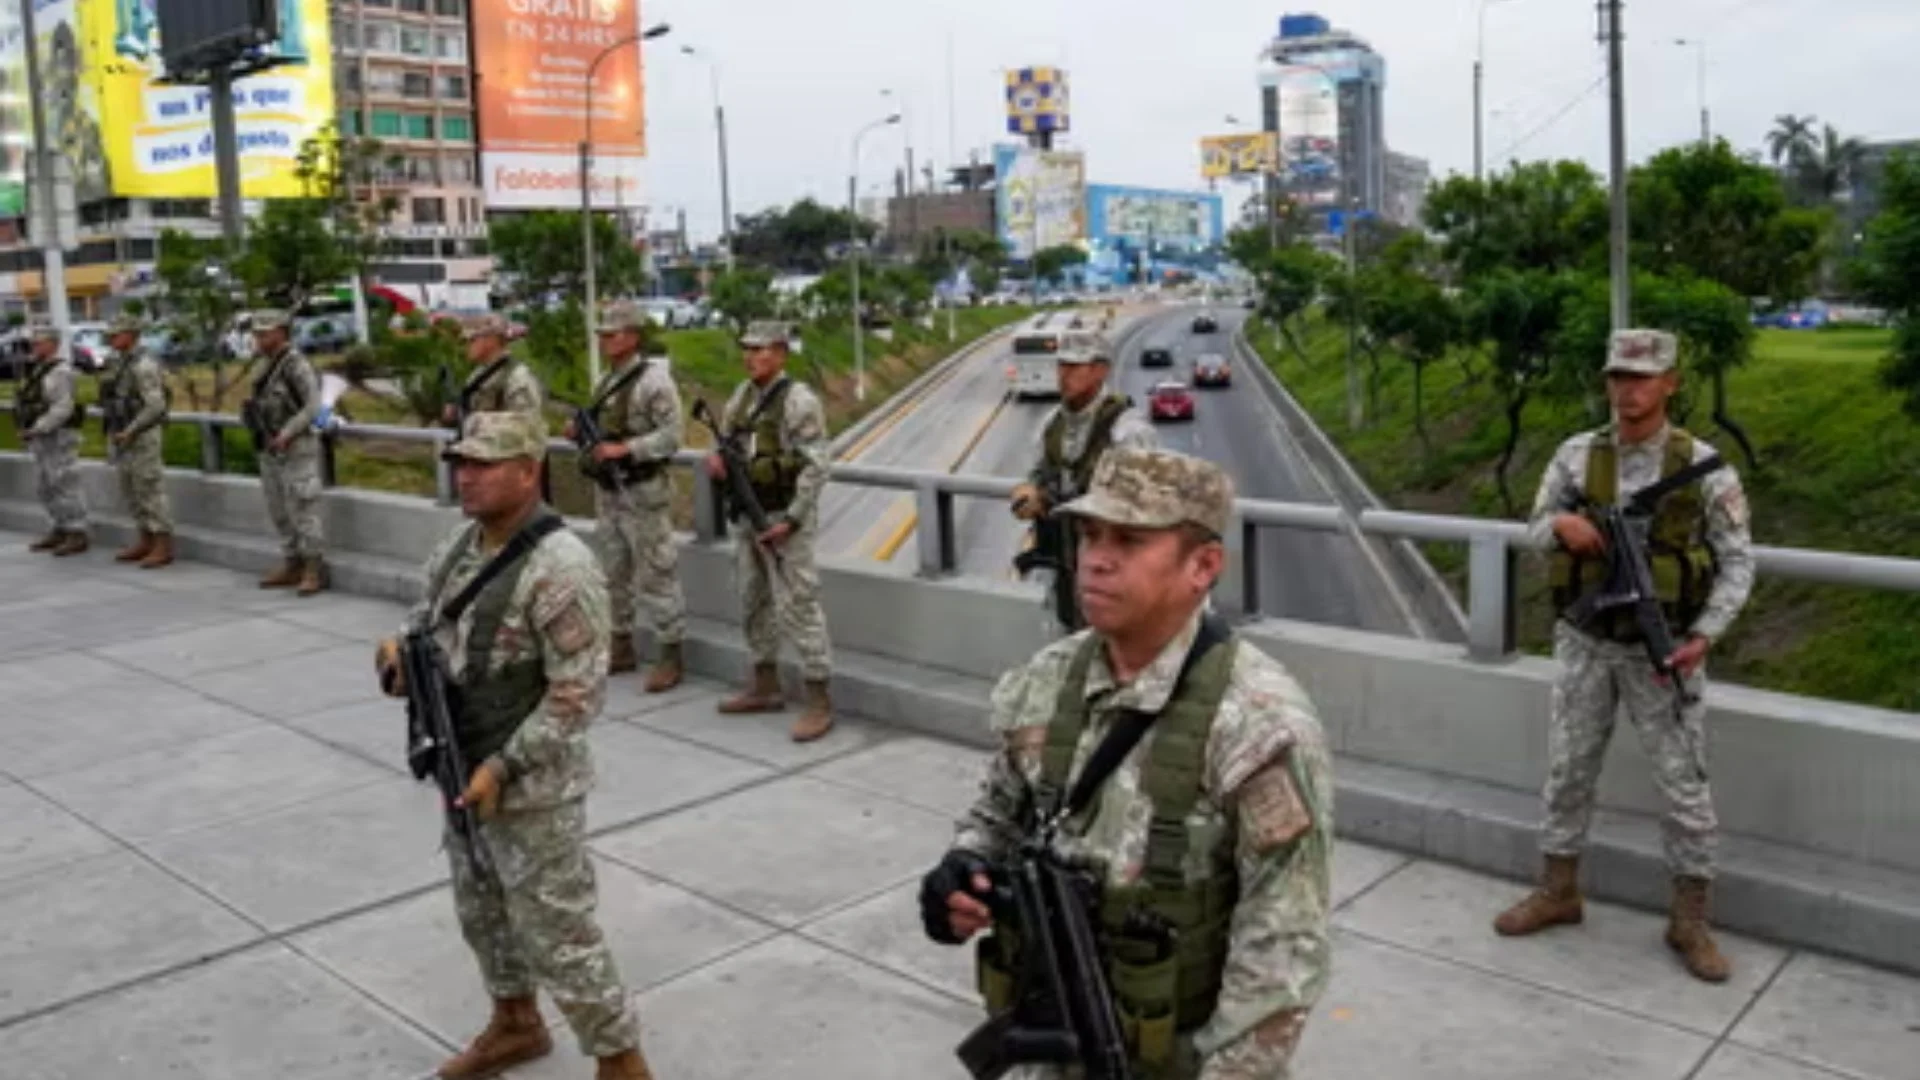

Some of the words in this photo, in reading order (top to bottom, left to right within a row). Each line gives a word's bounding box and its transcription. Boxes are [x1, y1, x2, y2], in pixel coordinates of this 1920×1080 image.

[509, 0, 617, 24] GRATIS
[544, 23, 571, 42] 24
[252, 89, 290, 107] que
[152, 143, 190, 163] nos
